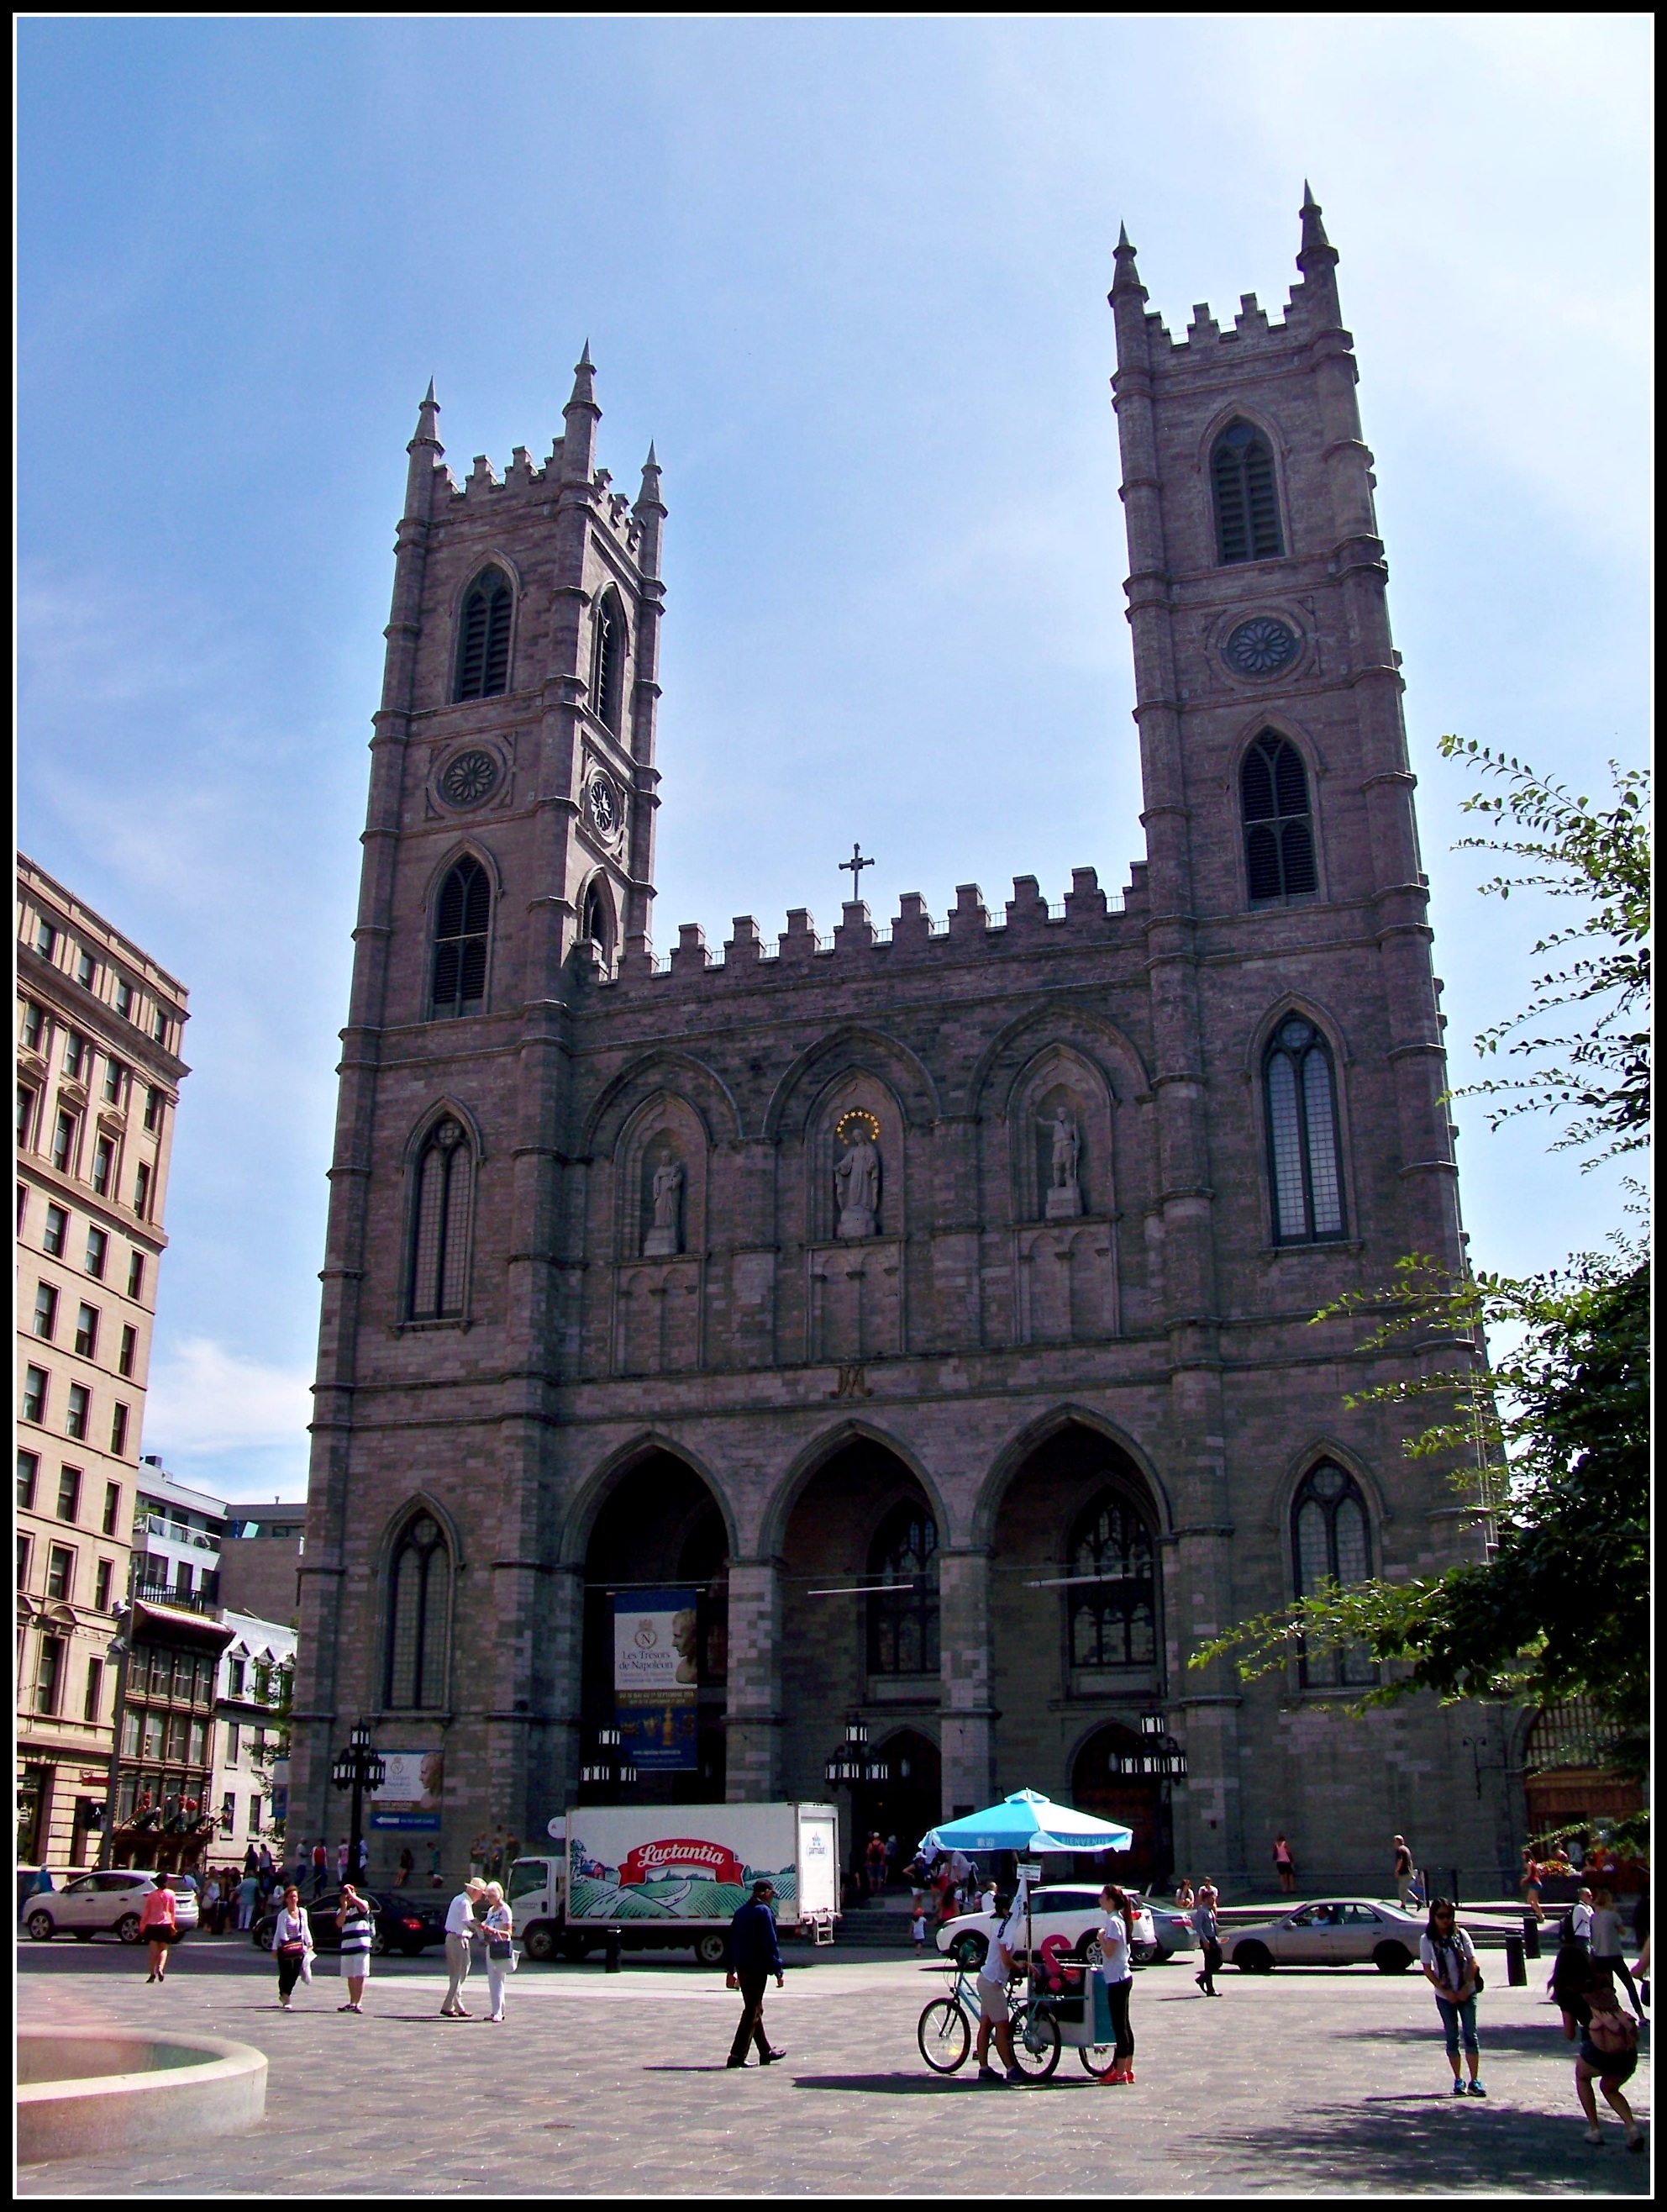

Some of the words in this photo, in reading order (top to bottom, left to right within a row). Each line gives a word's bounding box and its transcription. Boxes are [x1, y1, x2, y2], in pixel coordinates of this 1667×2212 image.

[642, 1633, 650, 1645] N
[623, 1651, 637, 1660] Les
[619, 1661, 630, 1670] de
[632, 1661, 673, 1671] Napoléon
[637, 1844, 724, 1867] Lactantia
